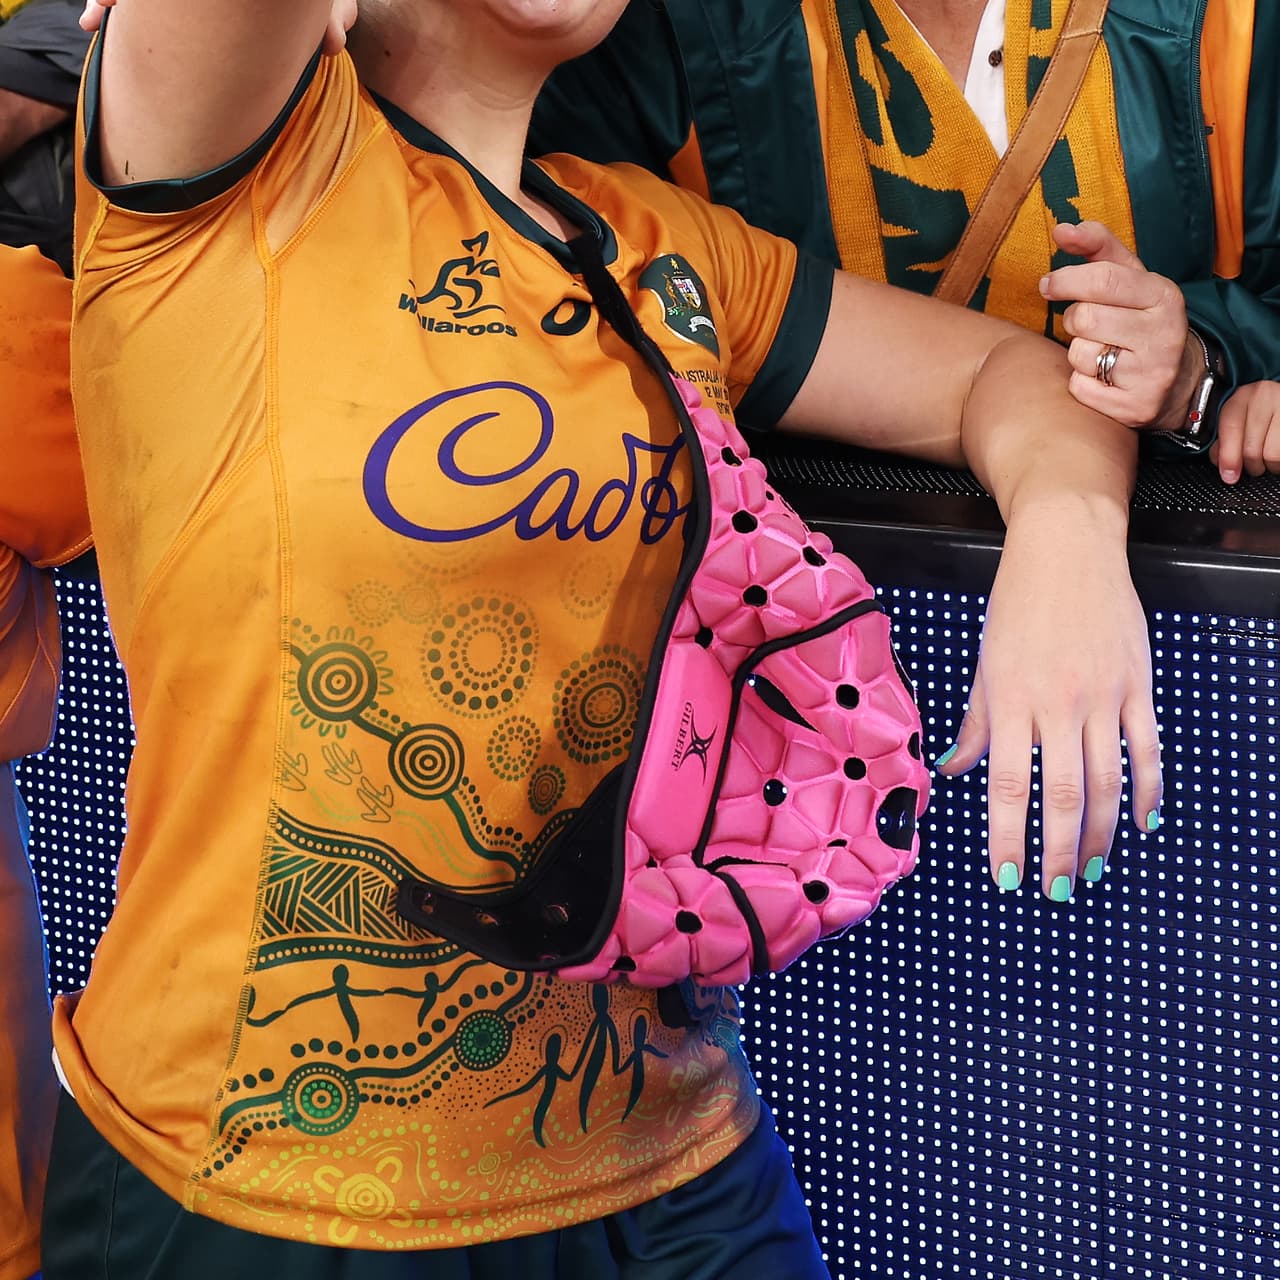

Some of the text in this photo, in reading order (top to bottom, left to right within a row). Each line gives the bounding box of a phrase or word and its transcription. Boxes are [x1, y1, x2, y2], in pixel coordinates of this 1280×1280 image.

[398, 293, 518, 337] Wllaroos
[363, 381, 690, 544] Cadb
[671, 701, 693, 772] GILBERT
